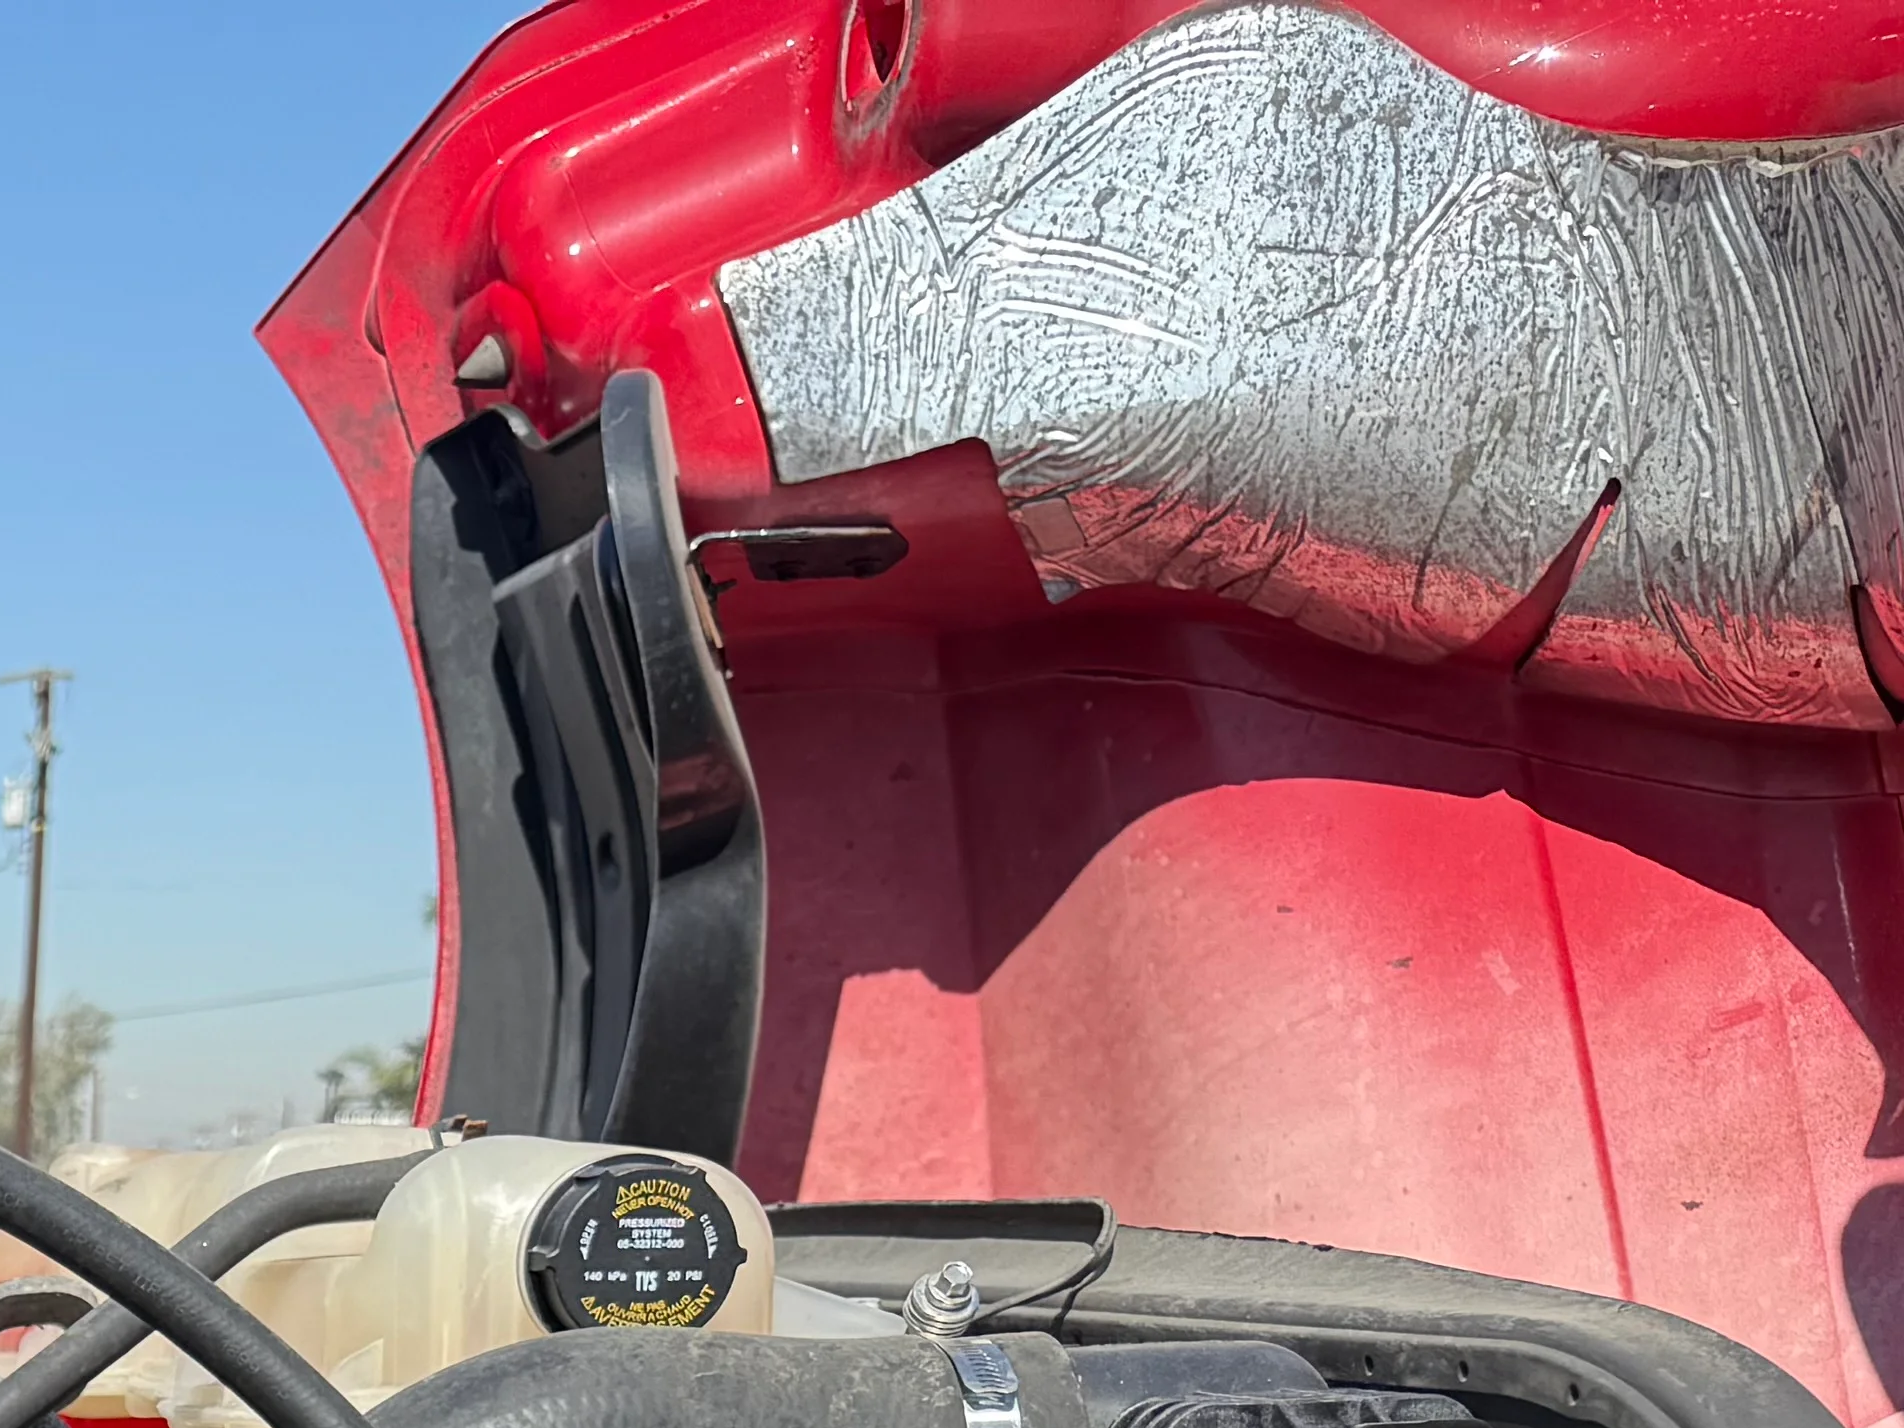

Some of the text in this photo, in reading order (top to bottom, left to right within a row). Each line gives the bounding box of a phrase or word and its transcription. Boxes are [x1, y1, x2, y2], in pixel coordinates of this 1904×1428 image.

[630, 1178, 691, 1201] CAUTION
[611, 1195, 695, 1220] NEVER OPEN HOT
[618, 1218, 686, 1228] PRESSURIZED
[631, 1229, 672, 1239] SYSTEM
[635, 1271, 658, 1292] TVS
[667, 1271, 703, 1281] 20 PSI
[629, 1300, 666, 1311] NE PAS
[655, 1295, 692, 1319] CHAUD
